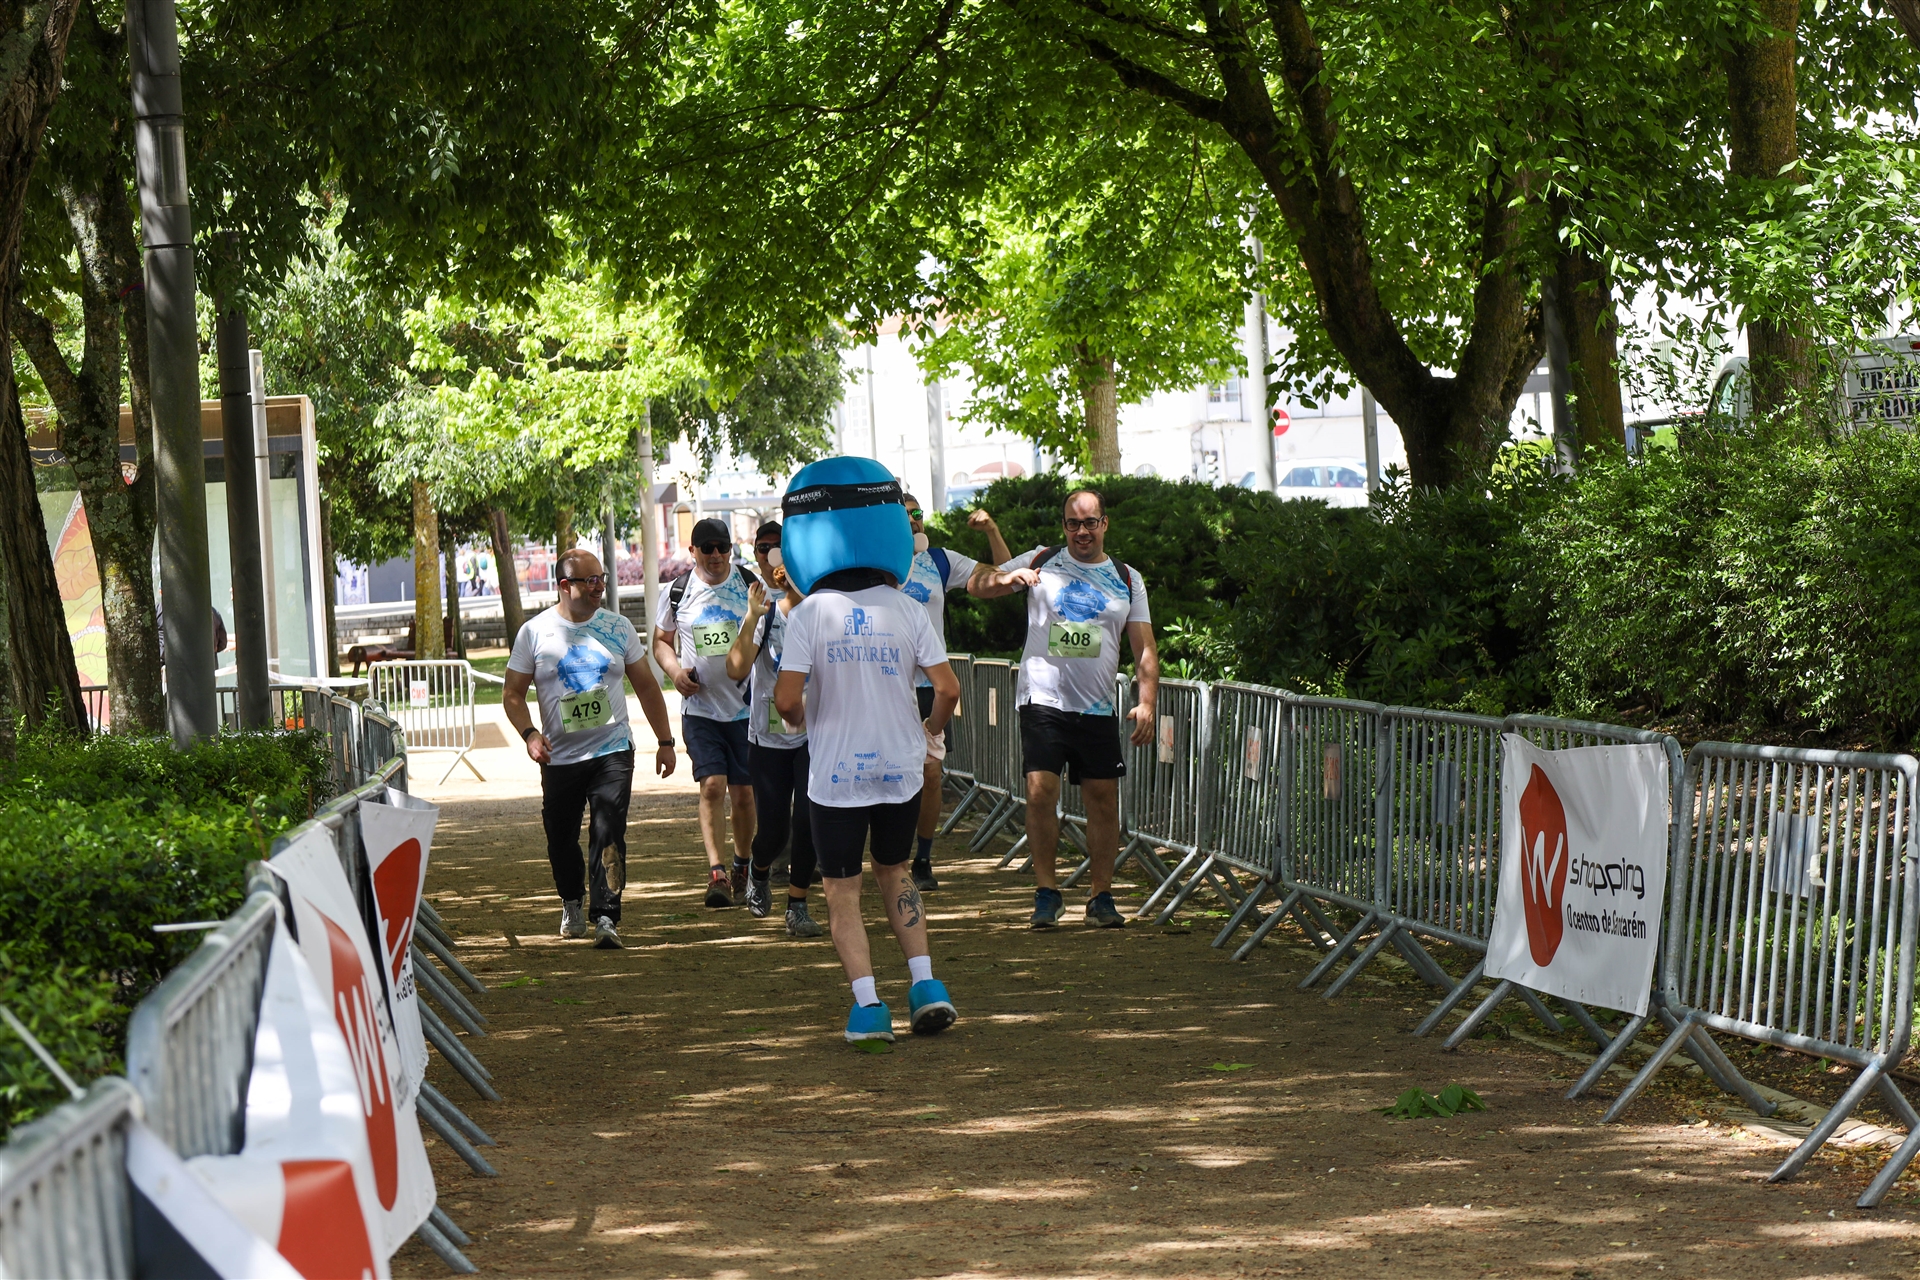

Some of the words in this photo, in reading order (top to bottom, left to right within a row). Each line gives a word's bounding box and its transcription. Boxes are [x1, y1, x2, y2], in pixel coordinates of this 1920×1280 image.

[703, 631, 730, 646] 523
[1060, 631, 1091, 647] 408
[827, 642, 900, 664] SANTARÉM
[881, 665, 899, 676] TRAIL
[411, 687, 426, 699] CMS
[572, 700, 602, 719] 479
[1569, 853, 1645, 899] shopping
[1566, 903, 1573, 928] O
[1573, 910, 1600, 933] centro
[1602, 908, 1611, 934] de
